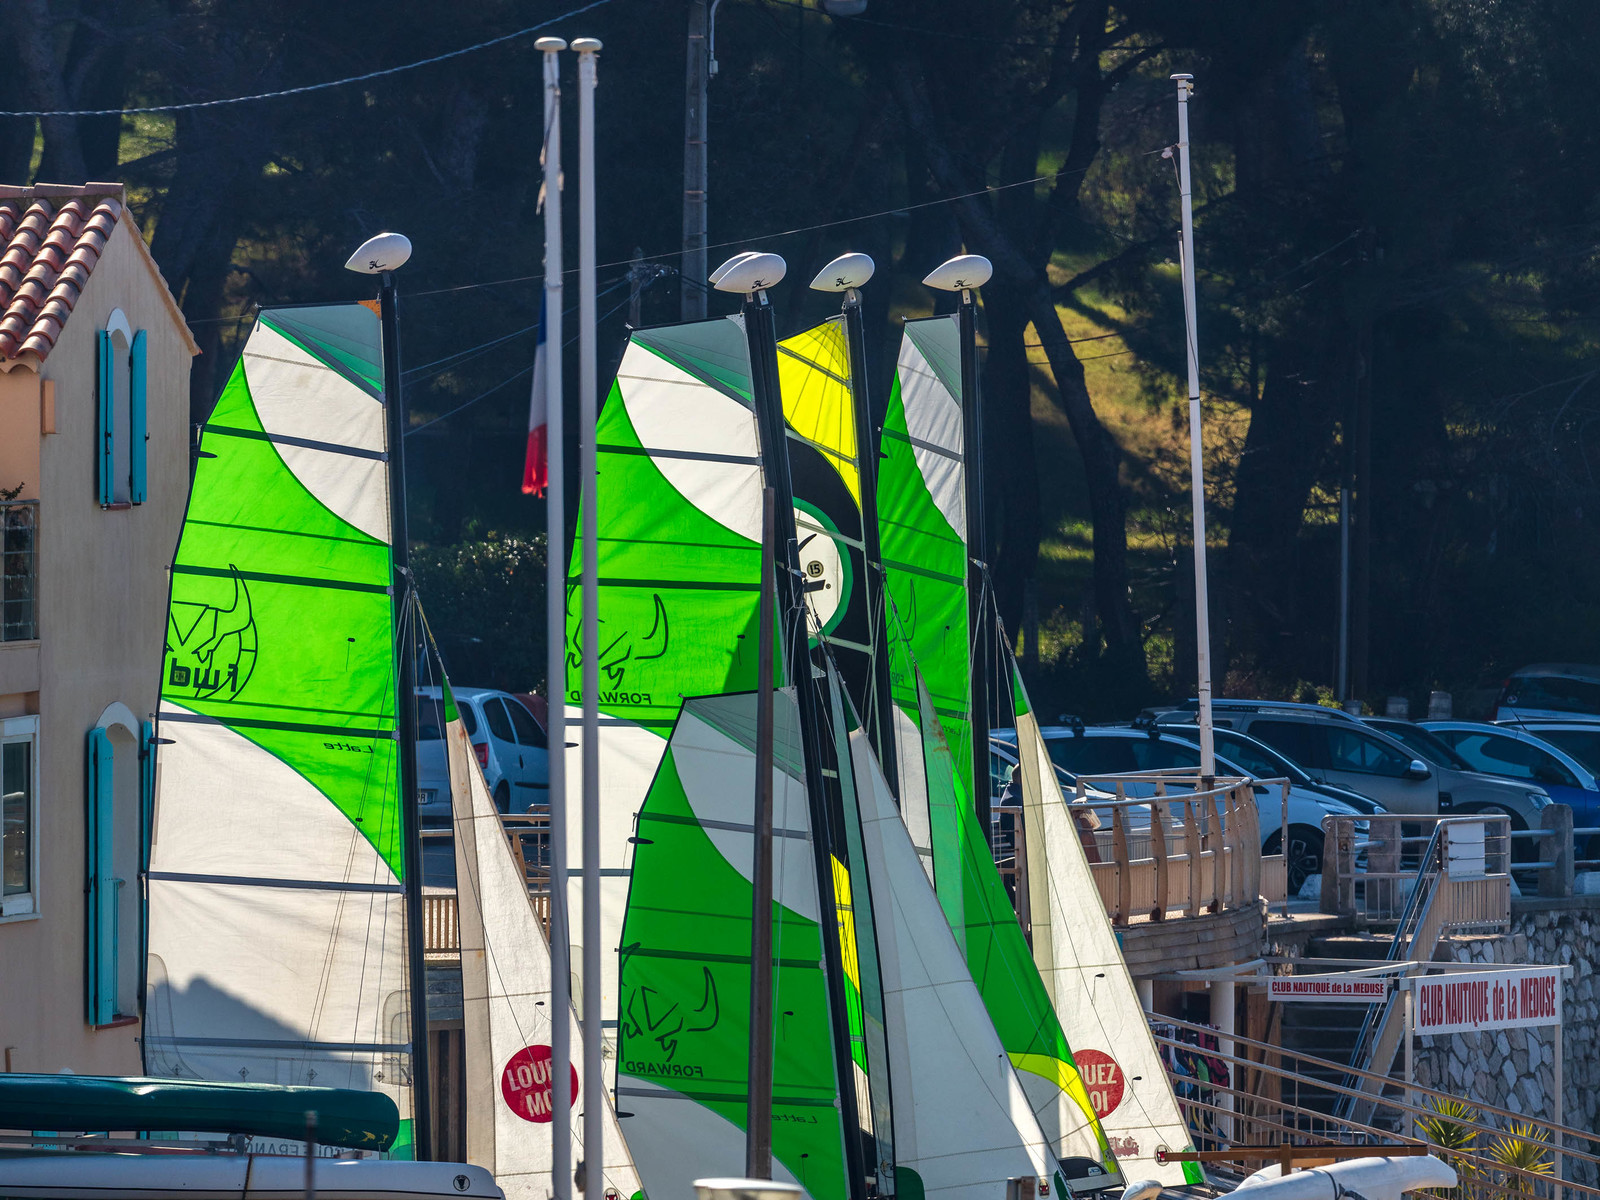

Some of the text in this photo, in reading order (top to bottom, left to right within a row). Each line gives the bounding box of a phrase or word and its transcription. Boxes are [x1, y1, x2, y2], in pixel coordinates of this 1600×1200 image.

[809, 563, 821, 575] 15
[1271, 981, 1384, 994] CLUB NAUTIQUE de La MEDUSE
[1420, 976, 1556, 1027] CLUB NAUTIQUE de La MEDUSE
[506, 1058, 553, 1092] LOU
[1077, 1063, 1118, 1086] UEZ
[525, 1089, 553, 1118] MO
[1089, 1090, 1109, 1112] OI
